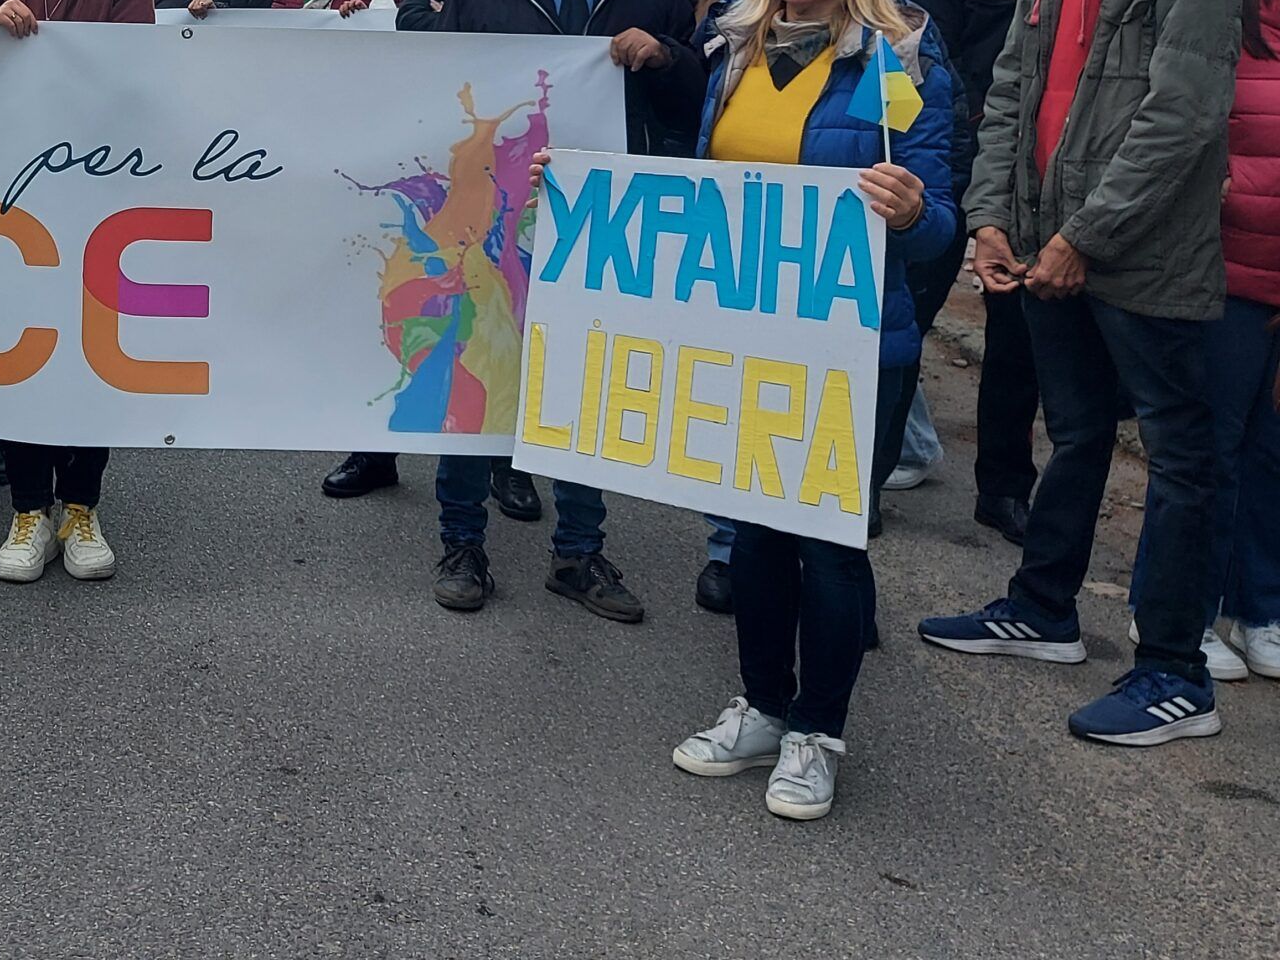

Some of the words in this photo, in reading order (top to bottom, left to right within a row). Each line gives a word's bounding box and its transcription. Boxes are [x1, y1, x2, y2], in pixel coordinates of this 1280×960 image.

[2, 140, 162, 215] per
[193, 129, 283, 182] la
[539, 163, 880, 331] УКРАЇНА
